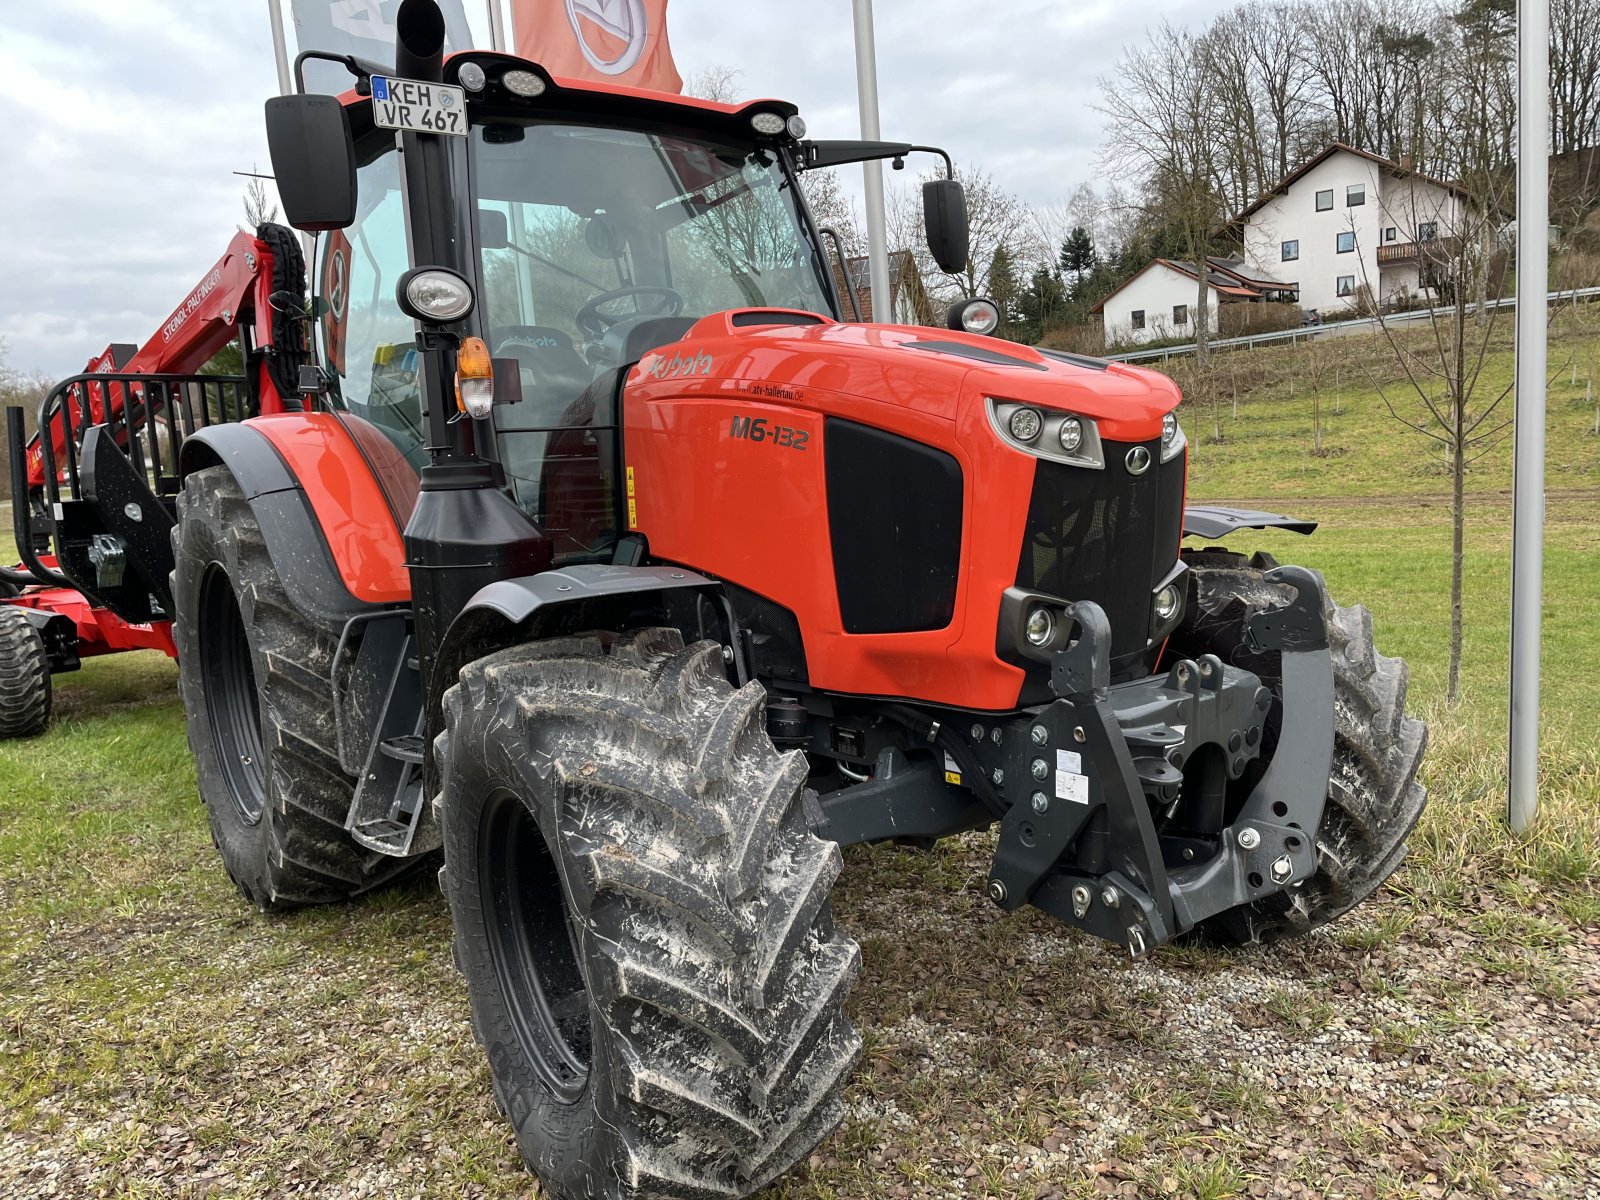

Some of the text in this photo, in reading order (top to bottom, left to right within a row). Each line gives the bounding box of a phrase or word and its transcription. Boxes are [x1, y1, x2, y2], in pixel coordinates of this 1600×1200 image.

[388, 81, 431, 107] KEH
[383, 103, 459, 132] VR 467
[163, 268, 221, 340] STEINDL-PALFINGER
[648, 348, 713, 379] Kubota
[729, 415, 810, 451] M6-132
